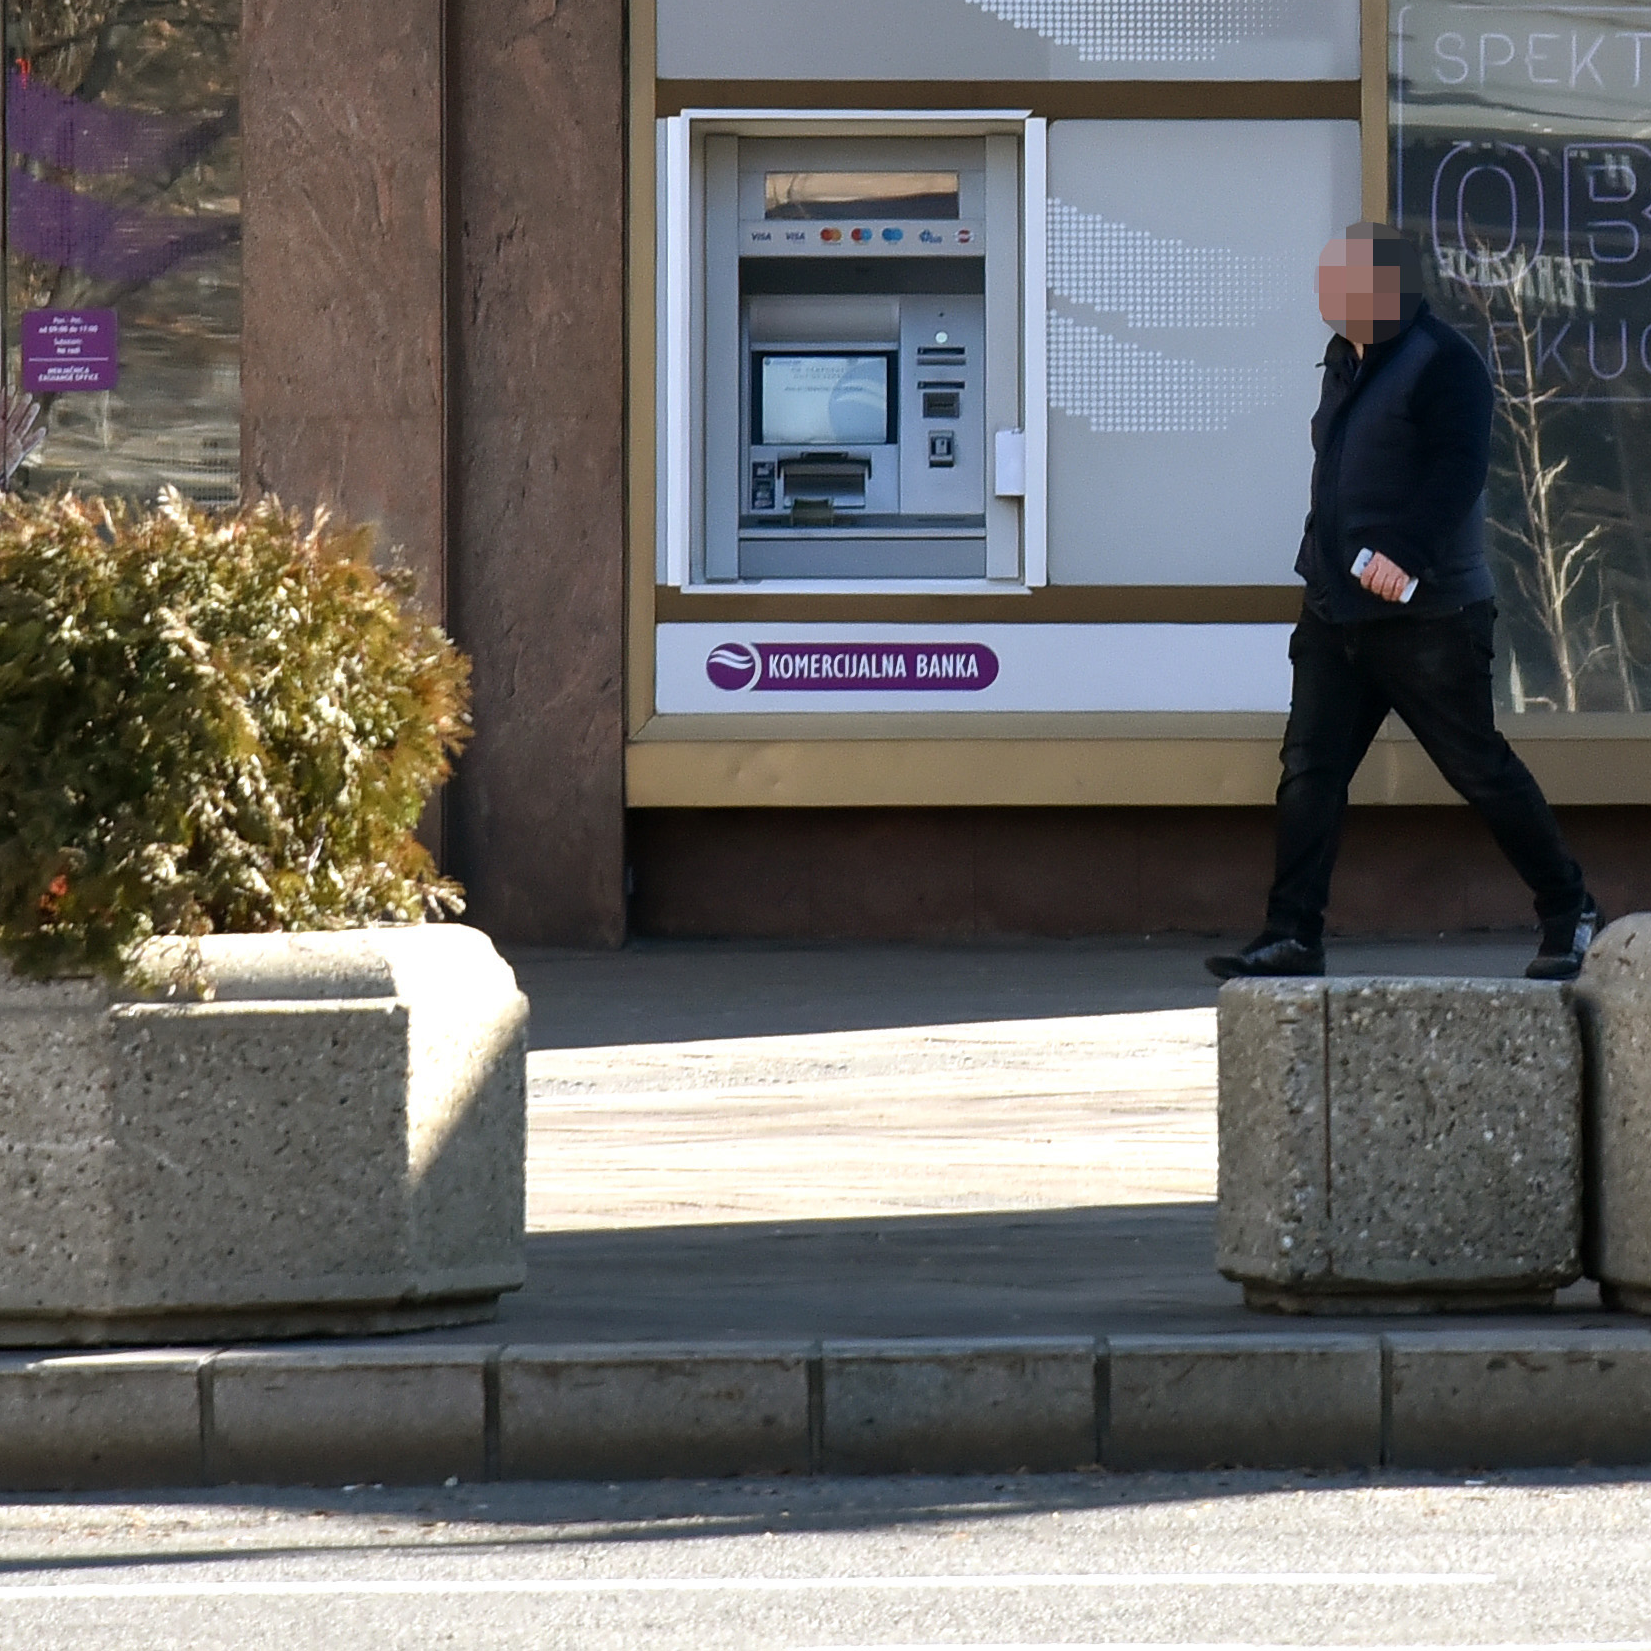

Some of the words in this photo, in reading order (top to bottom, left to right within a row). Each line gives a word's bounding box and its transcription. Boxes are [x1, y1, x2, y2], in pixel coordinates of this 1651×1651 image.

[751, 231, 772, 242] VISA
[767, 652, 907, 679] KOMERCIJALNA
[915, 652, 980, 679] BANKA
